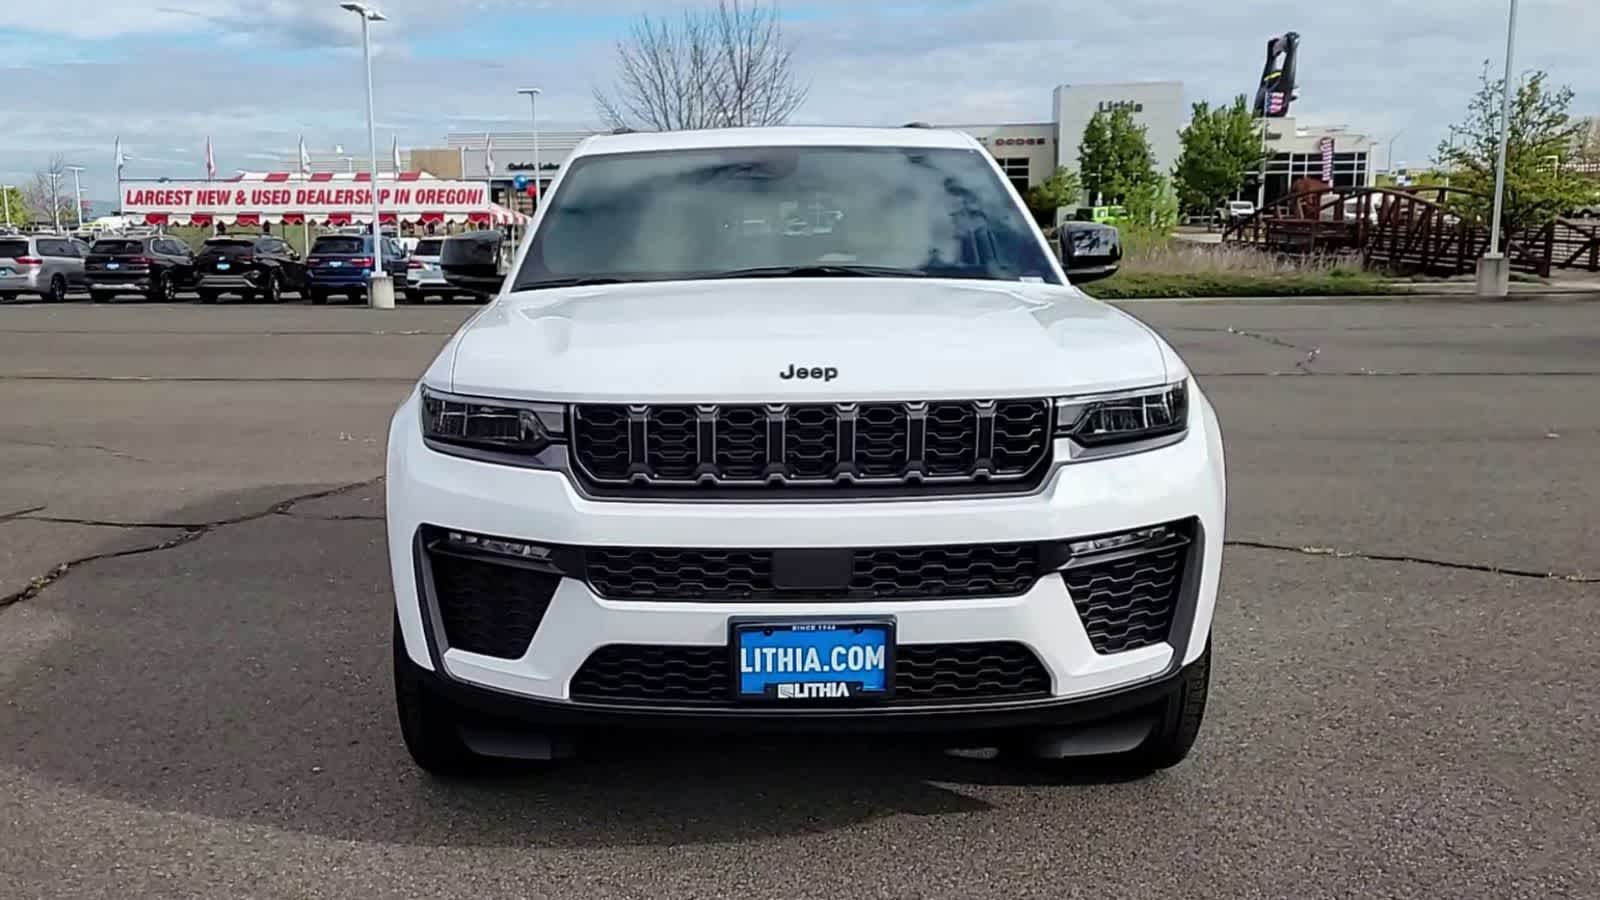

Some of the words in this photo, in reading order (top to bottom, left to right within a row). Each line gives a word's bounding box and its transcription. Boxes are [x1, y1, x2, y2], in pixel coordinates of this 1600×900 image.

[126, 190, 192, 205] LARGEST
[196, 189, 231, 205] NEW
[235, 189, 246, 205] &
[252, 189, 291, 205] USED
[394, 189, 410, 205] IN
[415, 189, 483, 205] OREGON!
[779, 363, 838, 382] Jeep
[740, 645, 885, 673] LITHIA.COM
[794, 682, 849, 698] LITHIA
